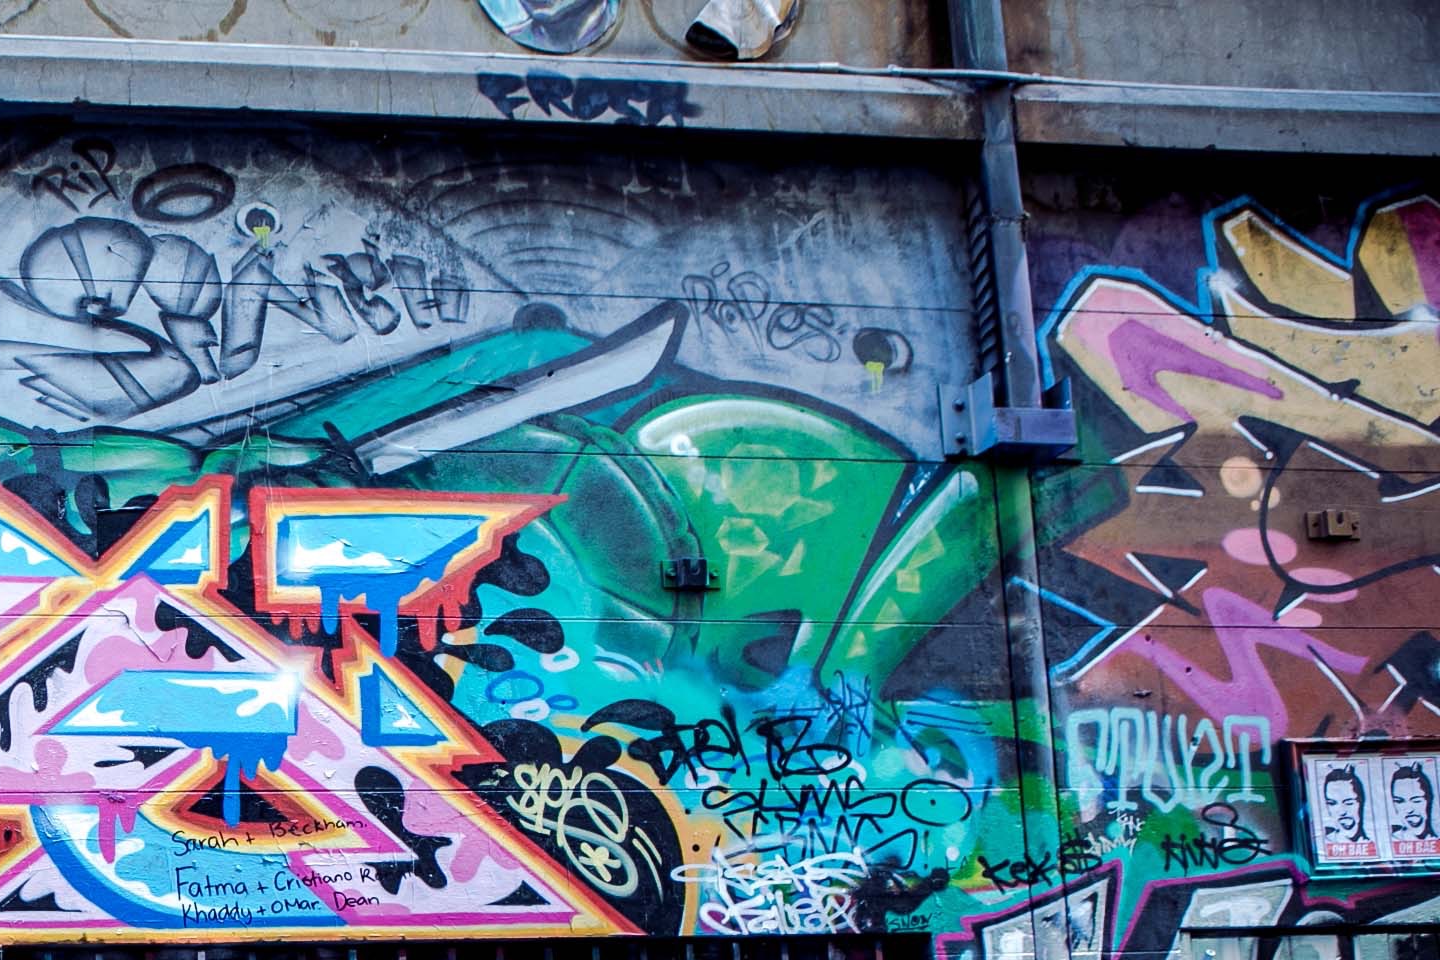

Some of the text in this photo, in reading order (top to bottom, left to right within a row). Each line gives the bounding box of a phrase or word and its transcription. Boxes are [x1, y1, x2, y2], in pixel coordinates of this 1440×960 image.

[171, 831, 240, 856] Sarah
[175, 866, 248, 901] Fatma
[274, 870, 353, 893] Cristiano
[181, 902, 253, 927] Khaddy
[335, 891, 380, 909] Dean
